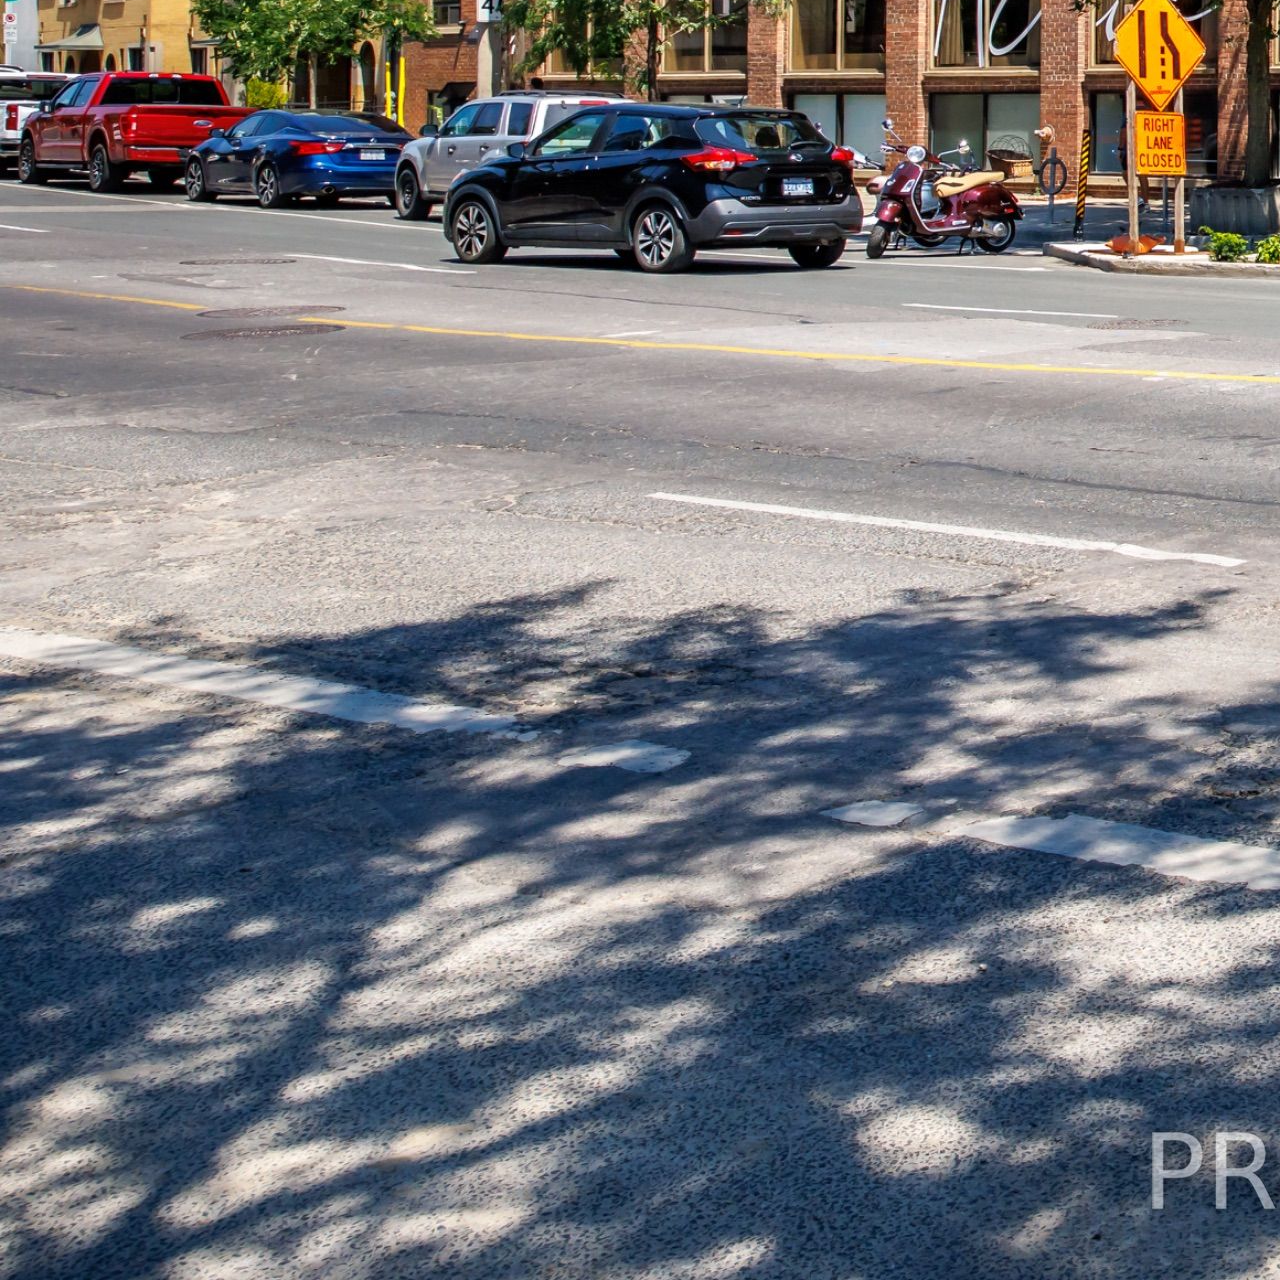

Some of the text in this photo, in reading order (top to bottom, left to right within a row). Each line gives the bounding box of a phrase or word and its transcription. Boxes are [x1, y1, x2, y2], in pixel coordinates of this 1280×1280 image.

[1143, 117, 1175, 132] RIGHT
[1146, 135, 1173, 150] LANE
[1139, 153, 1182, 168] CLOSED
